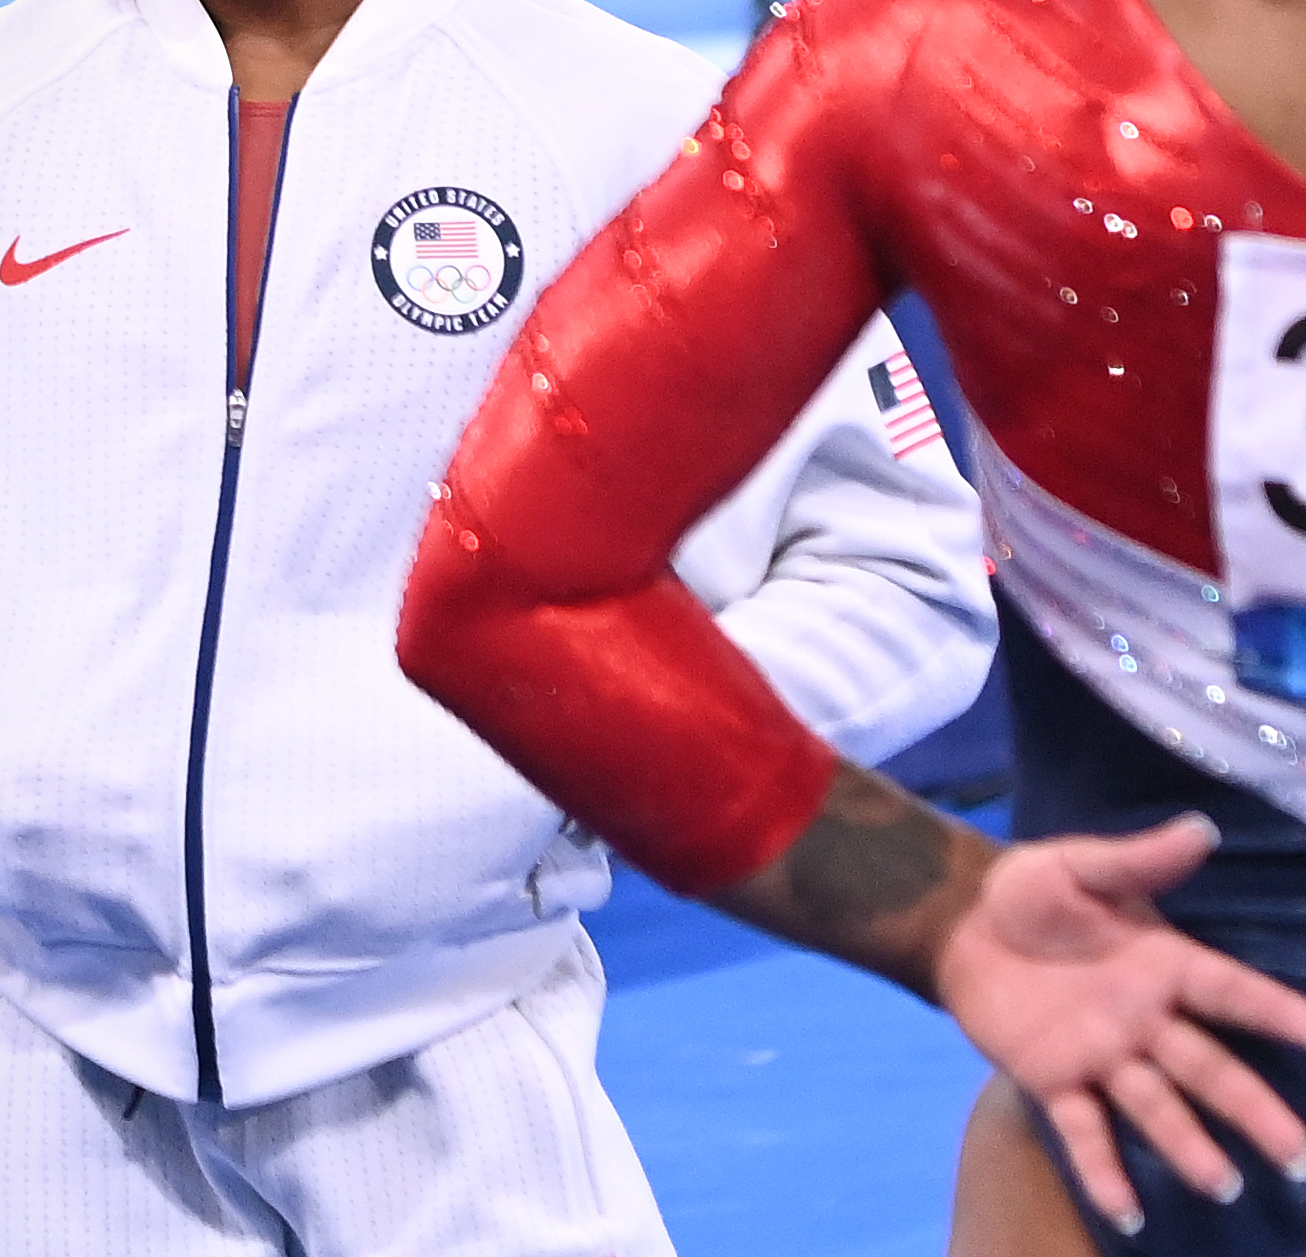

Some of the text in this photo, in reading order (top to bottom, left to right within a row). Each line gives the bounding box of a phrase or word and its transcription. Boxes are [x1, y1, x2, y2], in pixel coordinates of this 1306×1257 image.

[385, 188, 506, 228] UNITED STATES
[392, 293, 509, 331] OLYMPIC TEAM
